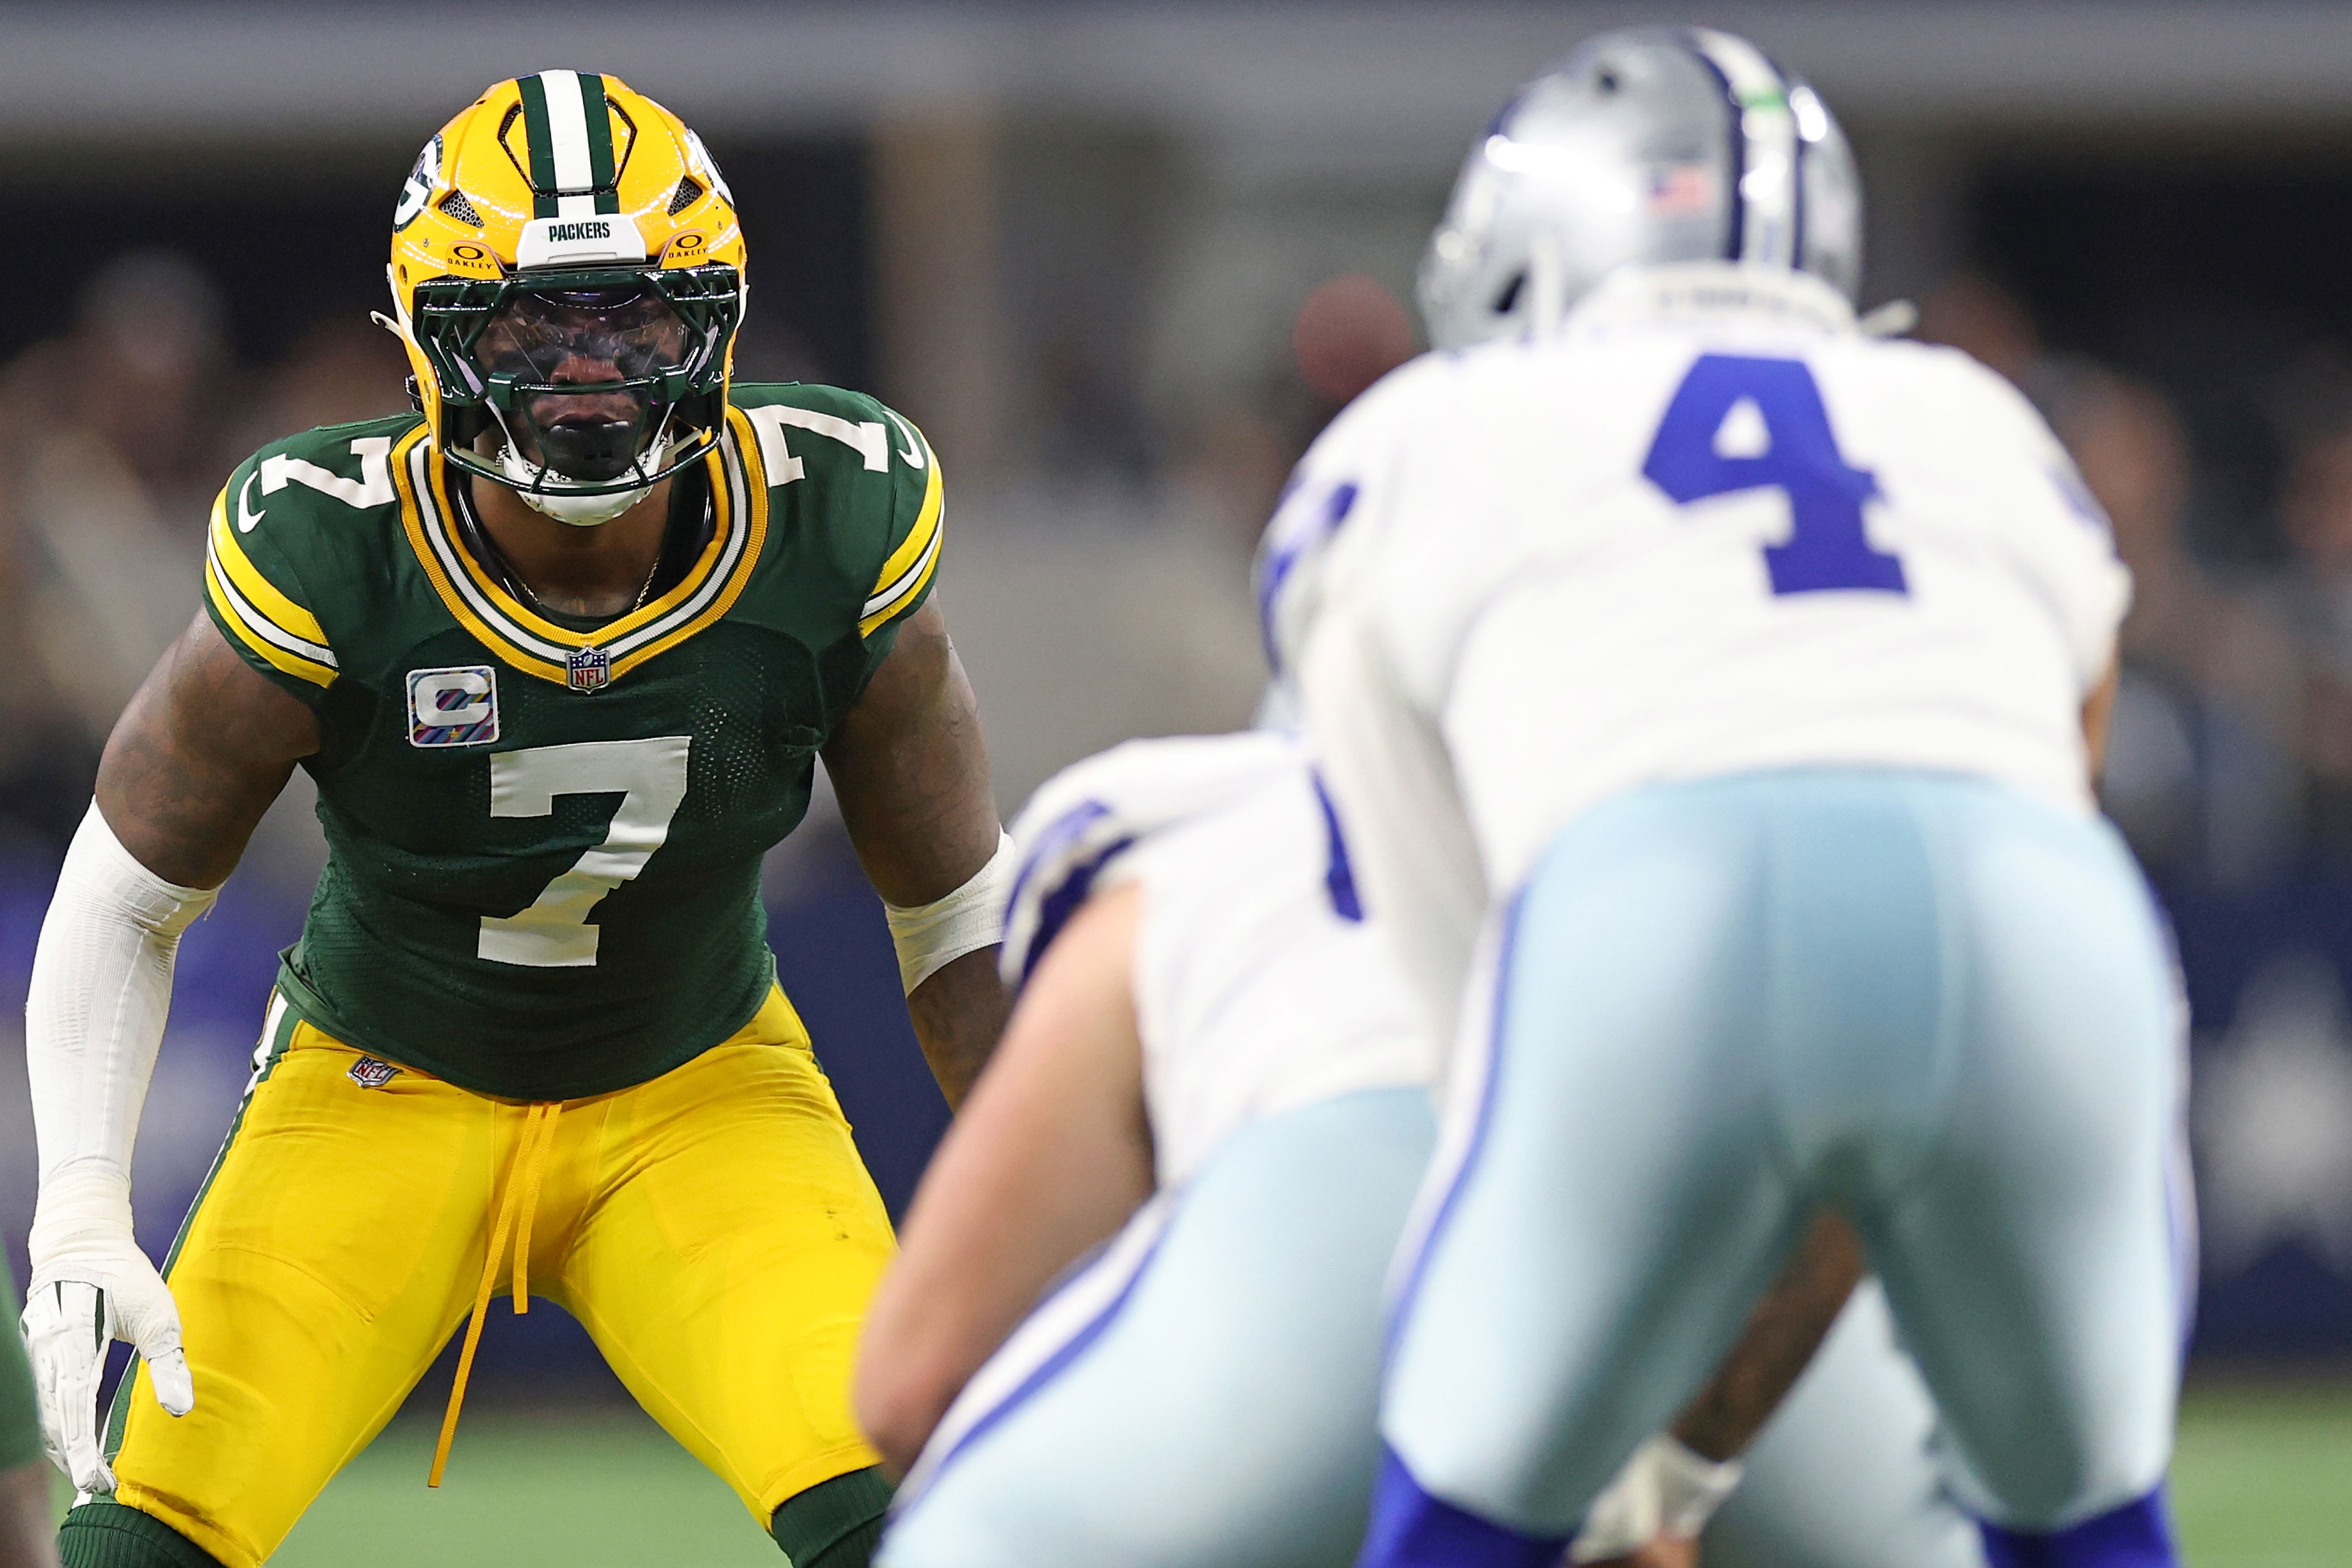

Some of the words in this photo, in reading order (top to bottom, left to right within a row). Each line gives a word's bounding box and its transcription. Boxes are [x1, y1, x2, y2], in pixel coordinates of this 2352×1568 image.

[549, 222, 610, 242] PACKERS
[447, 258, 492, 270] OAKLEY
[668, 248, 707, 258] OAKLEY
[744, 404, 889, 488] 7
[261, 436, 396, 509] 7
[1642, 353, 1908, 595] 4
[574, 669, 603, 687] NFL
[415, 673, 490, 726] C
[478, 735, 692, 966] 7
[356, 1064, 384, 1079] NFL
